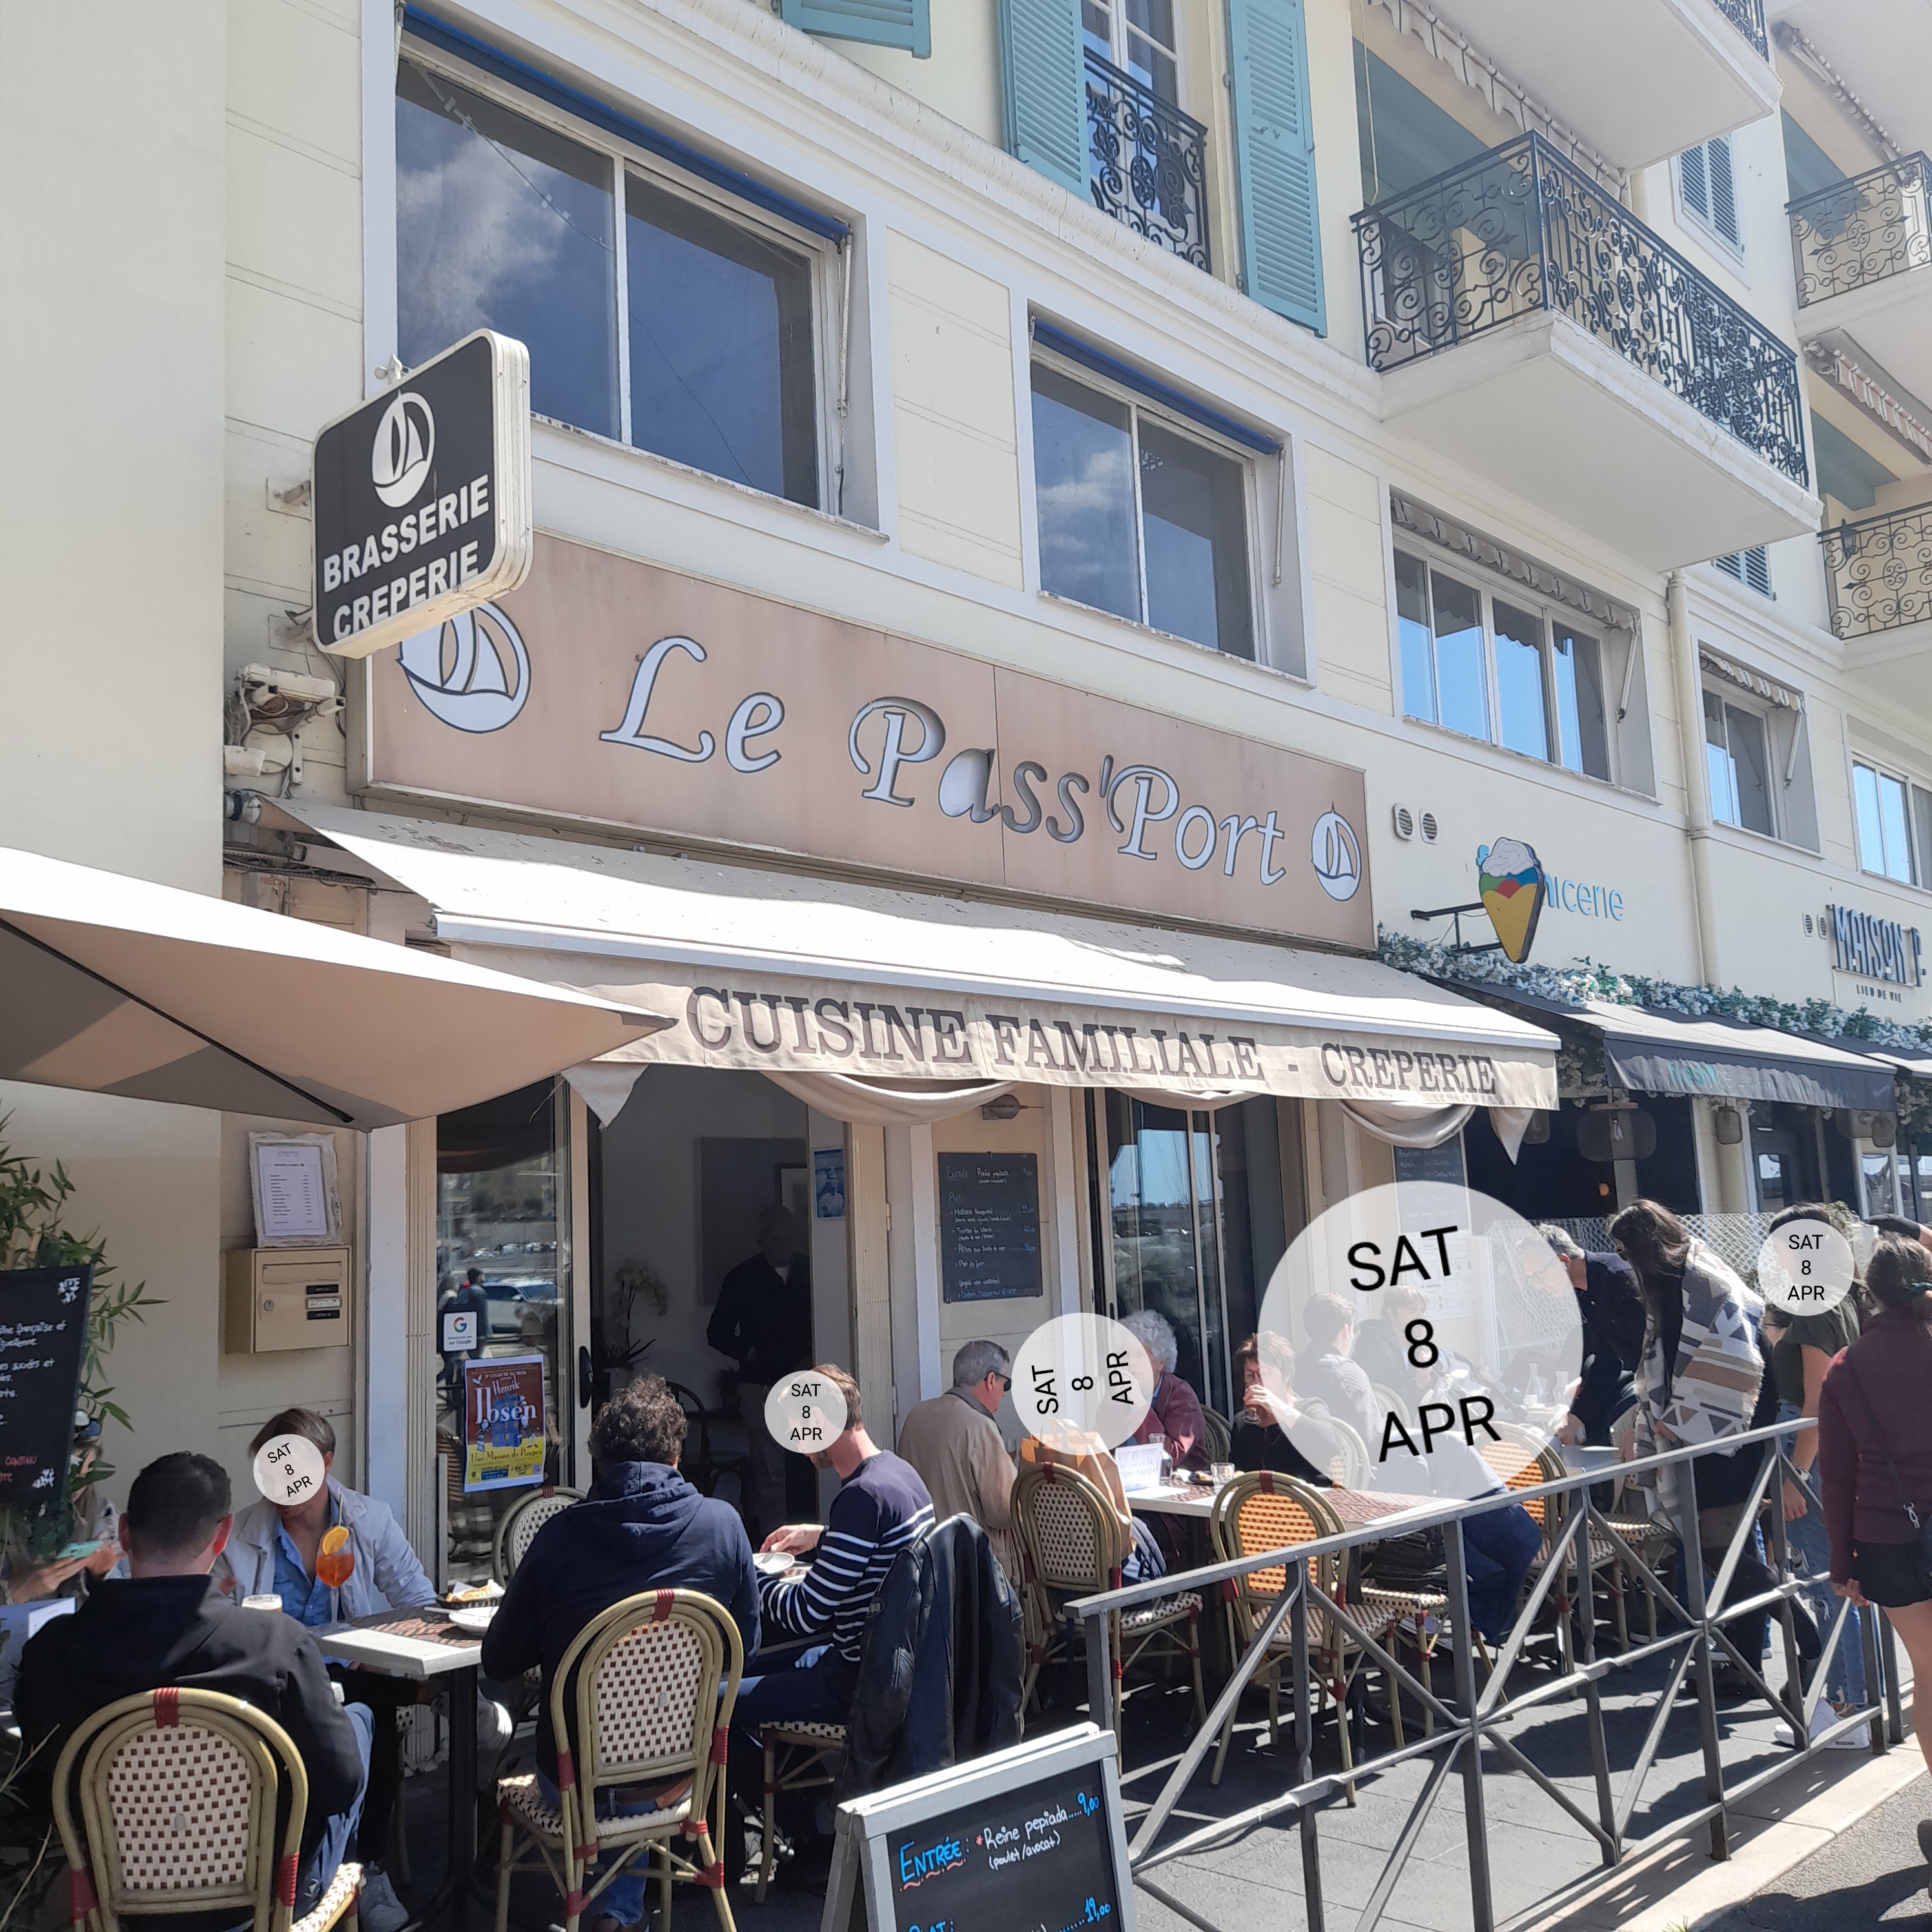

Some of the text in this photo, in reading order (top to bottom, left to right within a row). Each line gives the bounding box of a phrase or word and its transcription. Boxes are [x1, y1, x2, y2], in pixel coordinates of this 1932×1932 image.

[324, 473, 489, 593] BRASSERIE
[333, 540, 478, 642] CREPERIE
[599, 635, 785, 774] Le
[1832, 903, 1907, 985] MAISON
[1856, 983, 1903, 1003] LIEU DE VIE
[686, 985, 973, 1064] CUISINE
[984, 1013, 1266, 1080] FAMILIALE
[1321, 1042, 1498, 1096] CREPERIE
[475, 1386, 538, 1424] Ibsen
[492, 1373, 521, 1395] Henrik
[486, 1450, 510, 1461] Maison
